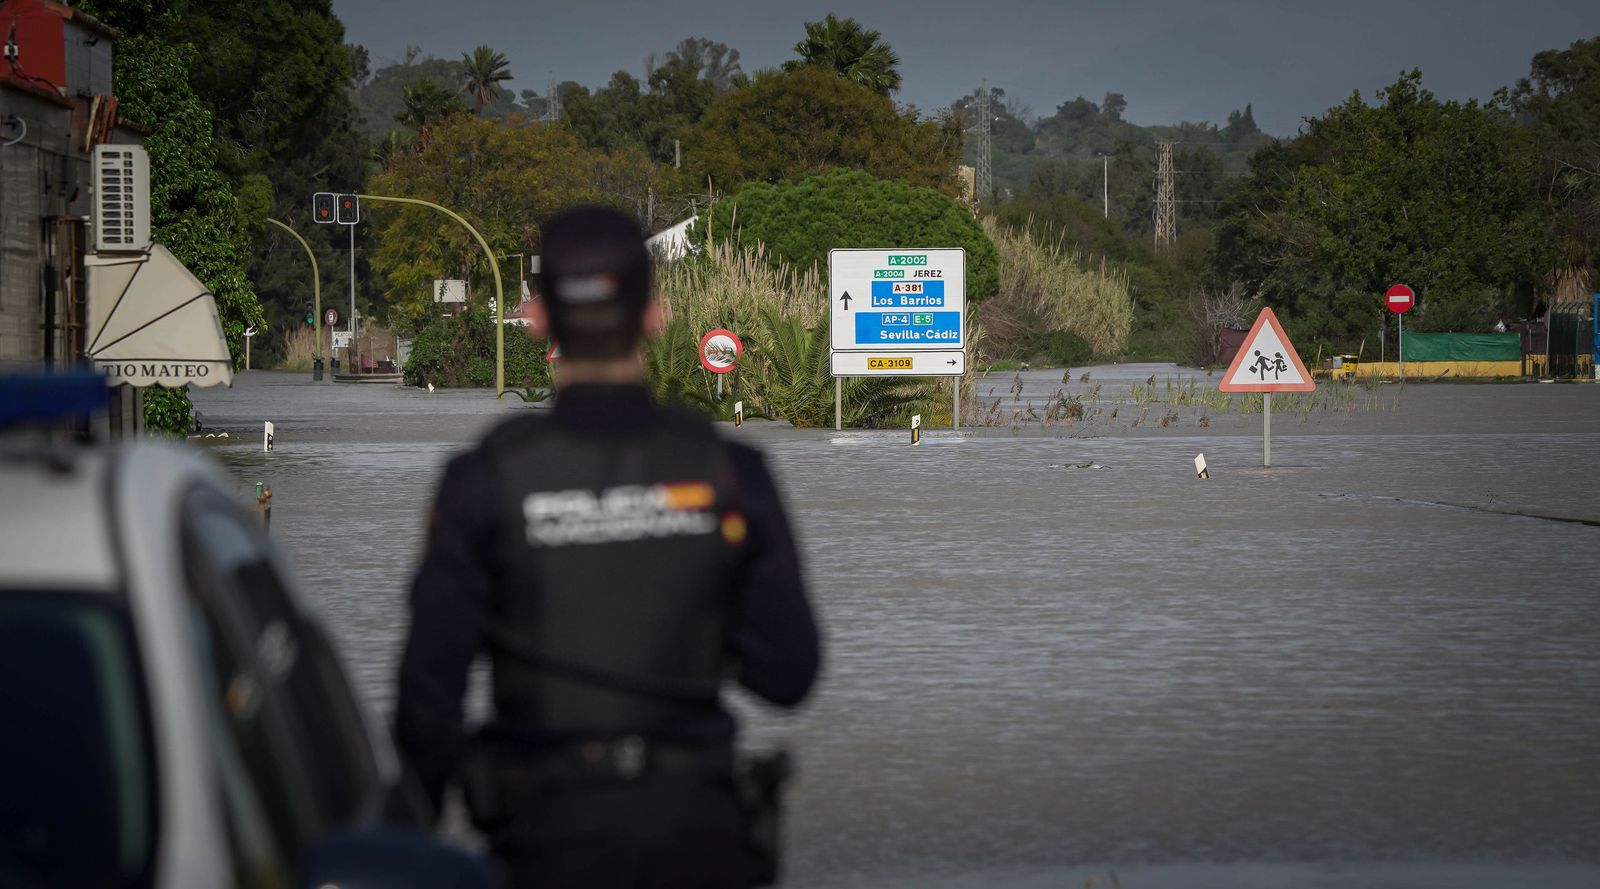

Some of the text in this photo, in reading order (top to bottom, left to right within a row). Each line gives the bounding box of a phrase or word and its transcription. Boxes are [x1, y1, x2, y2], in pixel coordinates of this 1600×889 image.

[889, 256, 926, 265] A-2002
[875, 270, 942, 278] A-2004 JEREZ
[894, 284, 922, 292] A-381
[873, 296, 942, 305] Los Barrios
[884, 315, 931, 324] AP-4 E-5
[880, 329, 958, 340] Sevilla-Cádiz
[870, 359, 911, 368] CA-3109
[141, 364, 209, 377] MATEO
